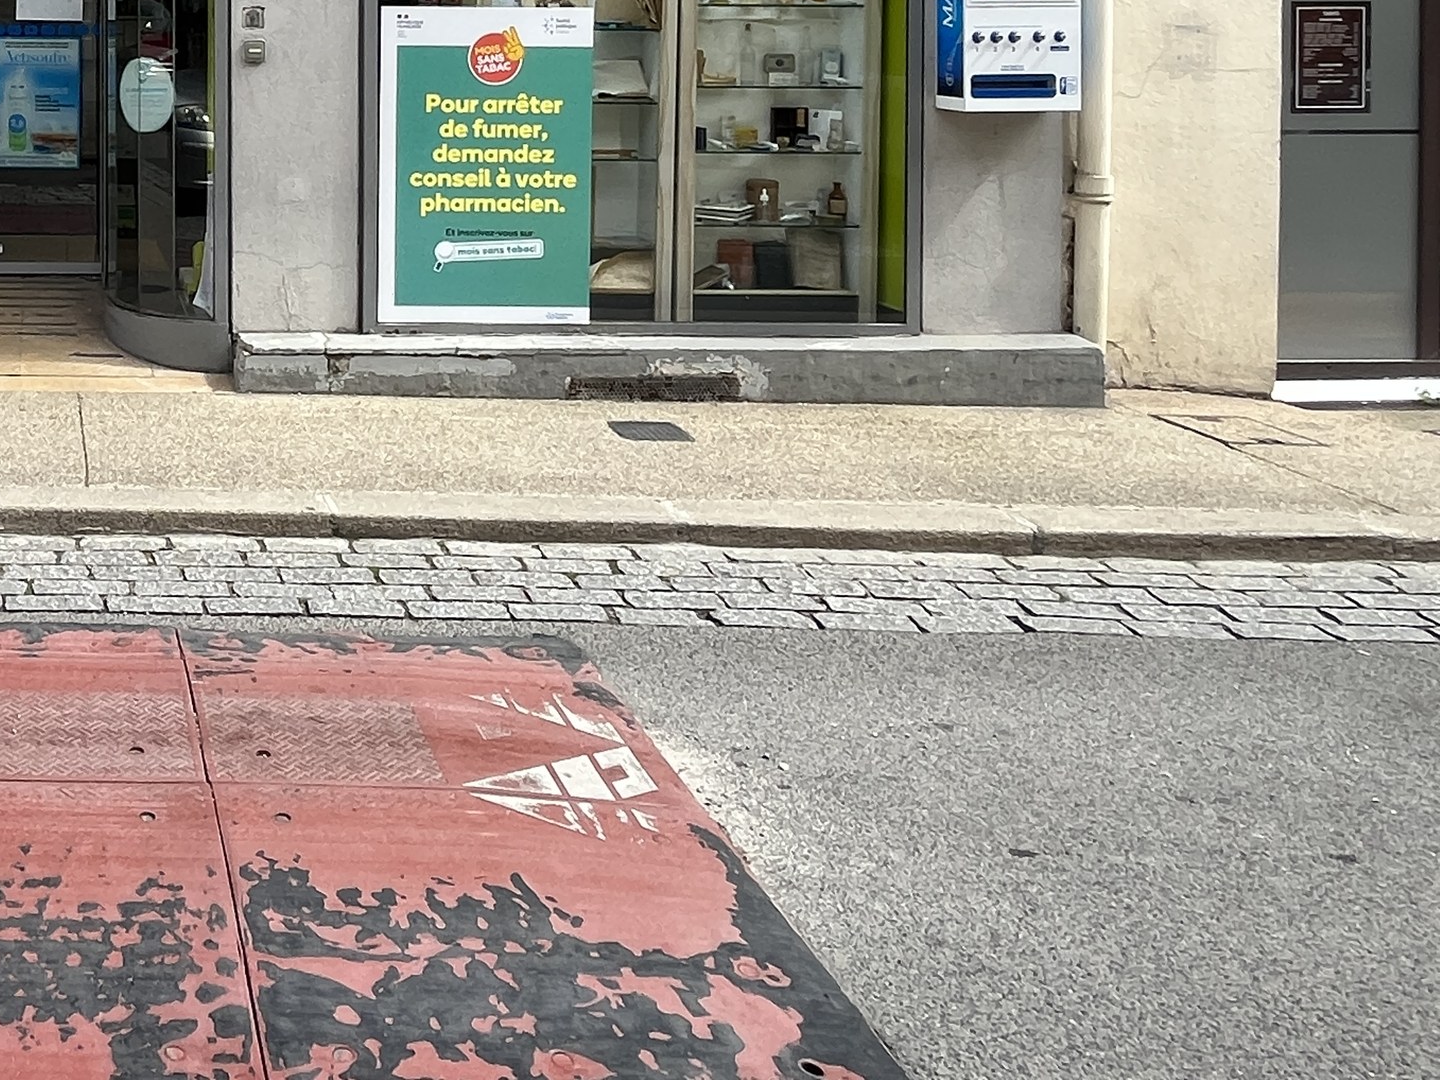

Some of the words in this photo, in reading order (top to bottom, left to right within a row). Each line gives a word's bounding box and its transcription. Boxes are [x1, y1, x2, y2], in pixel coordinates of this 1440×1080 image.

[474, 44, 501, 57] MOIS
[476, 52, 505, 65] SANS
[475, 61, 512, 74] TABAC
[425, 93, 479, 113] Pour
[482, 92, 564, 114] arrêter
[439, 118, 469, 138] de
[471, 117, 548, 141] fumer,
[432, 143, 555, 163] demandez
[409, 168, 492, 188] conseil
[495, 167, 511, 188] à
[515, 170, 577, 188] votre
[420, 192, 566, 217] pharmacien.
[445, 228, 455, 236] Et
[457, 247, 480, 256] mois
[482, 247, 505, 255] sans
[506, 245, 534, 254] tabac
